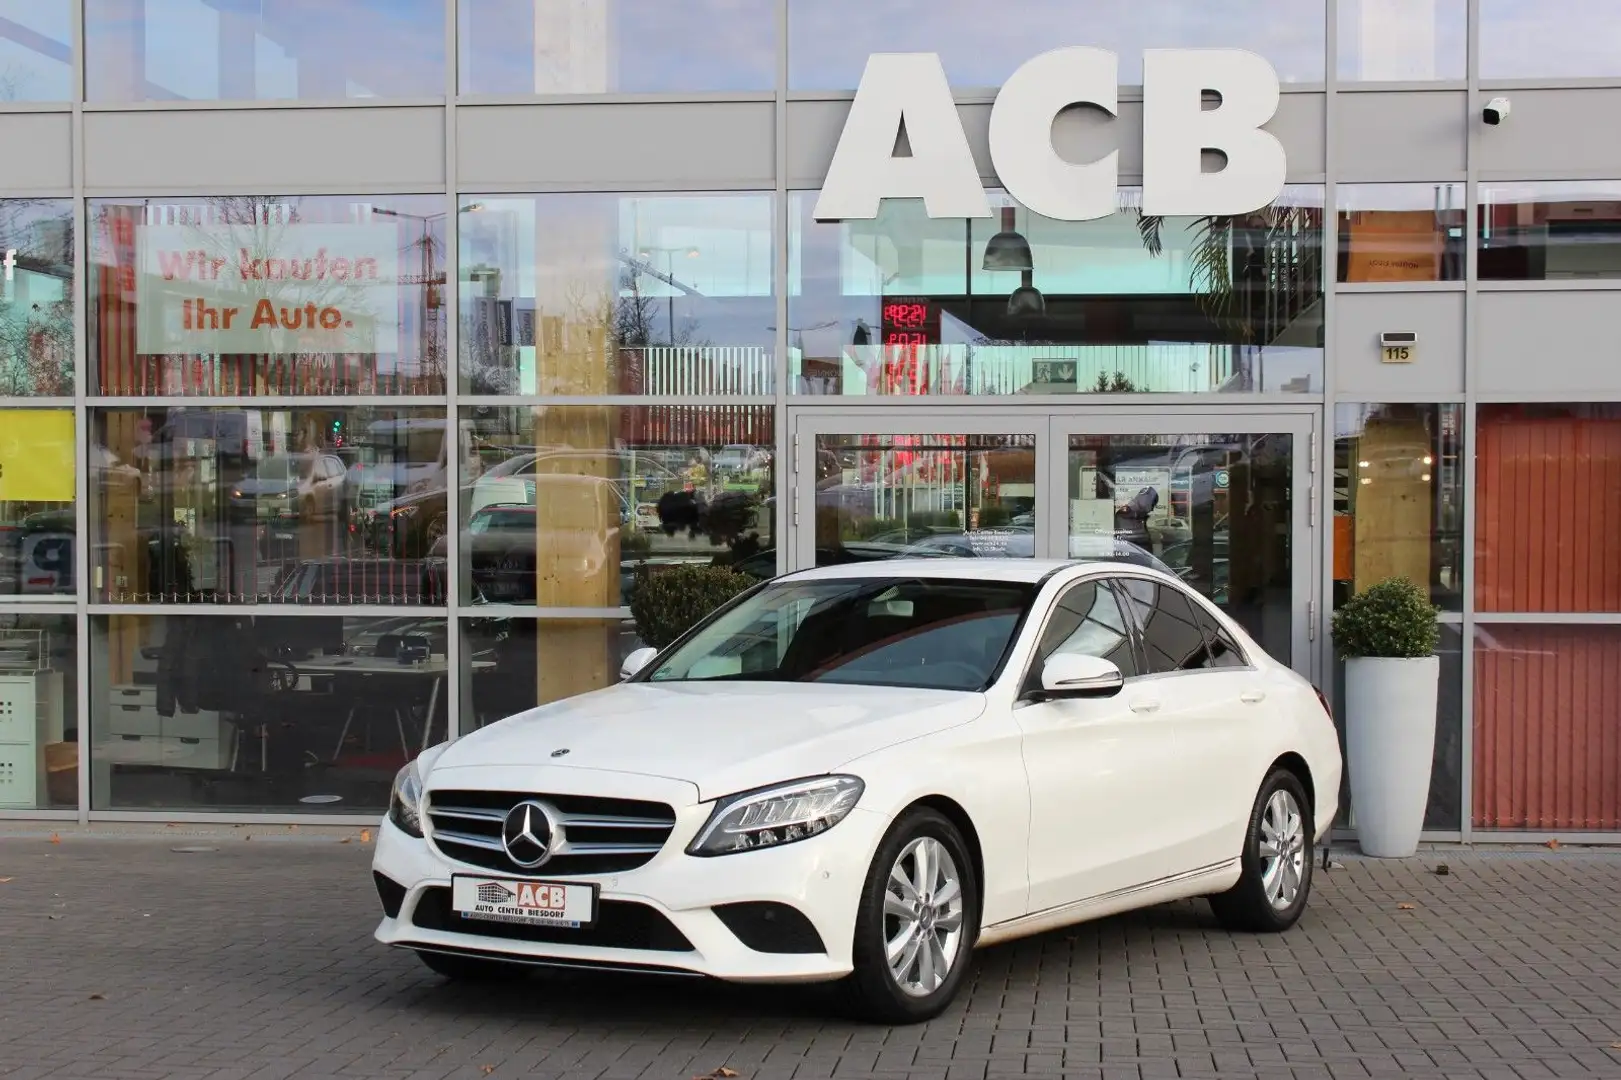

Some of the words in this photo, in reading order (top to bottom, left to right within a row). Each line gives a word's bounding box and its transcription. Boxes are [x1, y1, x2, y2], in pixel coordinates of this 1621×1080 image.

[813, 46, 1287, 220] ACB
[239, 247, 378, 282] kaufen
[250, 298, 354, 331] Auto.
[1386, 347, 1409, 361] 115
[520, 885, 566, 908] ACB
[475, 904, 494, 913] AUTO
[498, 906, 524, 915] CENTER
[528, 909, 565, 919] BIESDORF
